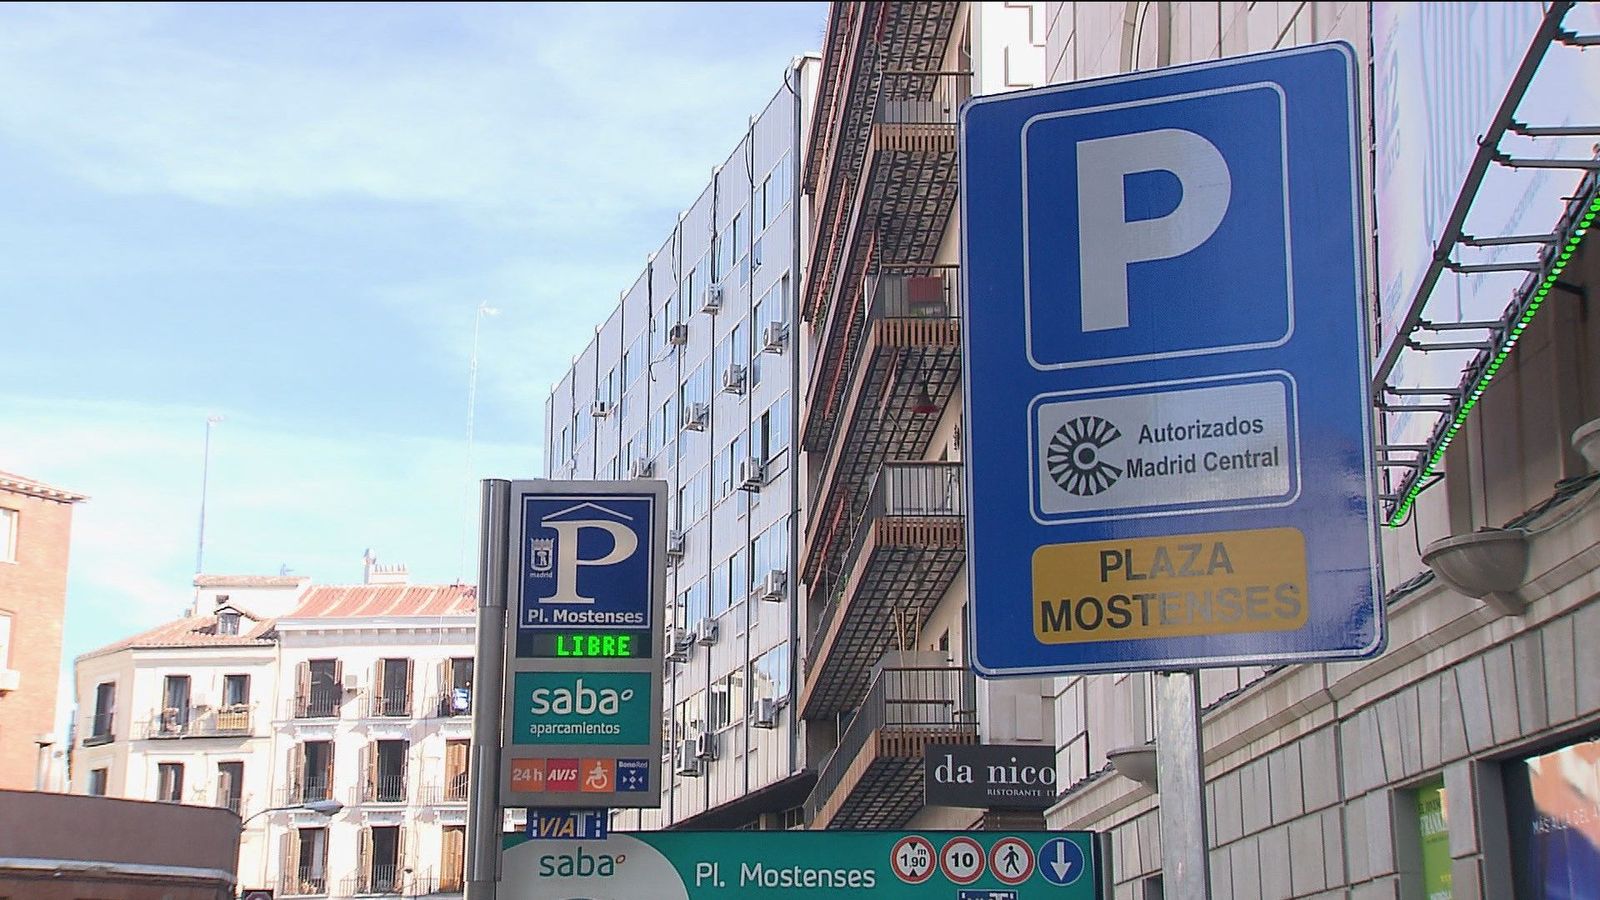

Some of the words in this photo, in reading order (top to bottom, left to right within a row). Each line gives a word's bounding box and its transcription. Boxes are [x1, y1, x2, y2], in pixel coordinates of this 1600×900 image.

[1076, 128, 1232, 333] P
[1138, 416, 1264, 445] Autorizados
[1126, 453, 1197, 479] Madrid
[1203, 446, 1279, 472] Central
[539, 519, 638, 604] P
[1099, 541, 1235, 583] PLAZA
[528, 608, 549, 623] Pl.
[553, 609, 644, 624] Mostenses
[1040, 583, 1301, 633] MOSTENSES
[556, 635, 631, 656] LIBRE
[529, 722, 621, 737] aparcamientos
[547, 769, 578, 781] AVIS
[934, 754, 974, 785] da
[986, 757, 1056, 785] nico
[987, 788, 1041, 797] RISTORANTE
[951, 852, 974, 868] 10
[695, 862, 726, 888] Pl.
[740, 862, 876, 888] Mostenses
